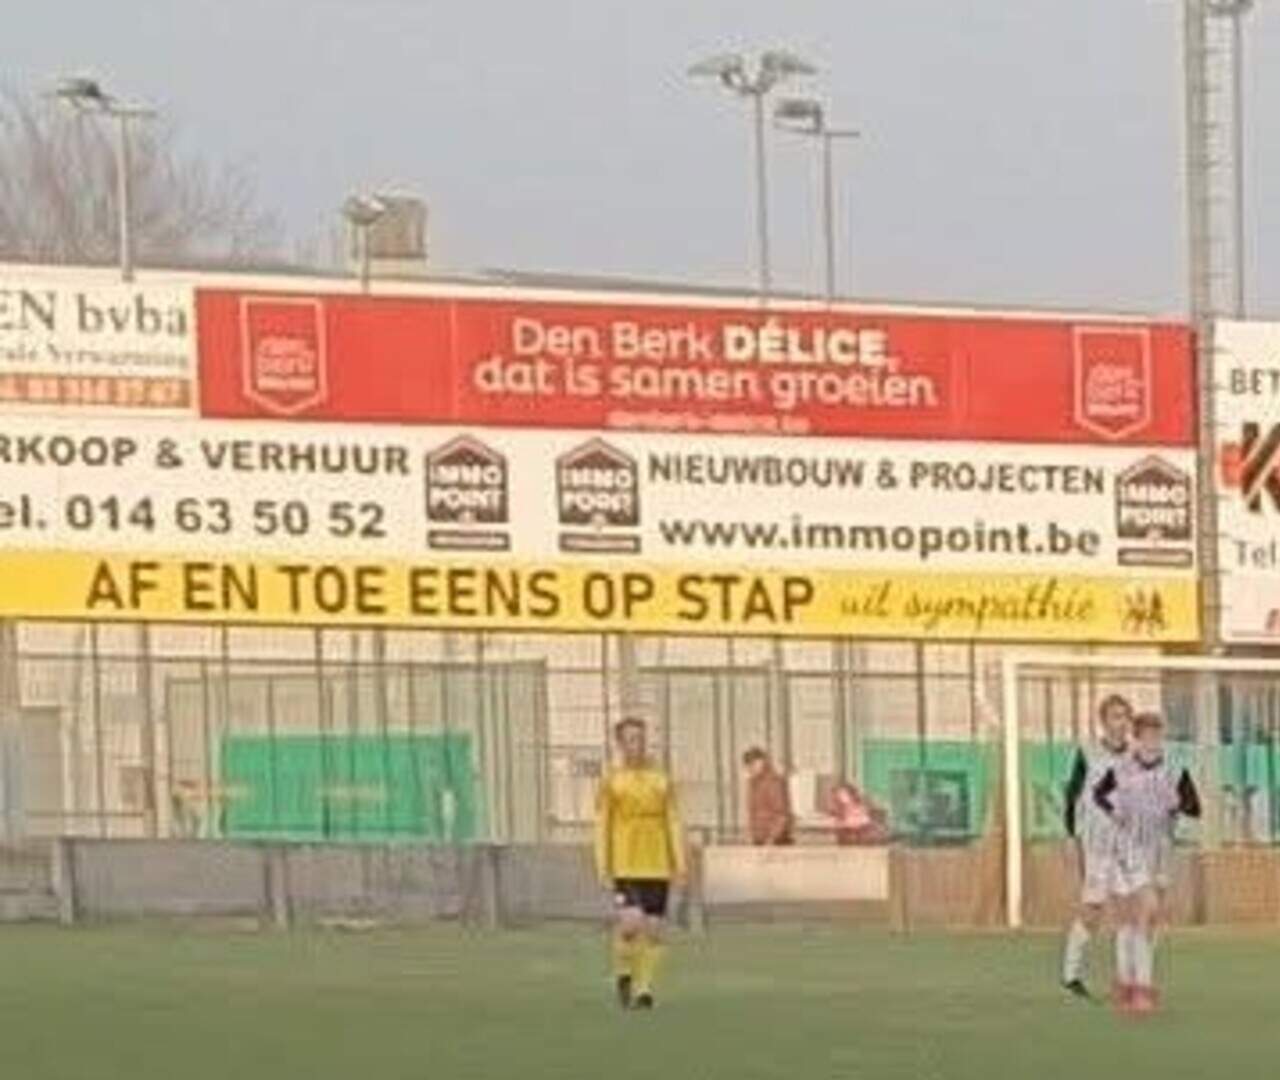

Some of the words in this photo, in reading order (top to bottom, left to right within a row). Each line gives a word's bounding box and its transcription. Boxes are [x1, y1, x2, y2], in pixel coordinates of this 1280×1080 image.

[77, 292, 187, 337] bvba
[514, 319, 602, 357] Den
[612, 322, 709, 361] Berk
[475, 357, 553, 394] dat
[565, 361, 600, 397] is
[611, 365, 756, 400] samen
[771, 370, 935, 409] groeien
[156, 439, 183, 469] &
[201, 441, 411, 475] VERHUUR
[648, 453, 866, 490] NIEUWBOUW
[876, 461, 898, 491] &
[908, 462, 1106, 496] PROJECTEN
[66, 495, 155, 531] 014
[174, 499, 234, 534] 63
[253, 501, 311, 537] 50
[327, 503, 387, 538] 52
[658, 514, 1102, 561] www.immopoint.be
[86, 560, 163, 610] AF
[182, 562, 260, 613] EN
[278, 565, 387, 615] TOE
[408, 568, 560, 618] EENS
[582, 571, 654, 621] OP
[676, 573, 816, 623] STAP
[840, 584, 892, 622] uit
[904, 579, 1097, 631] sympathie
